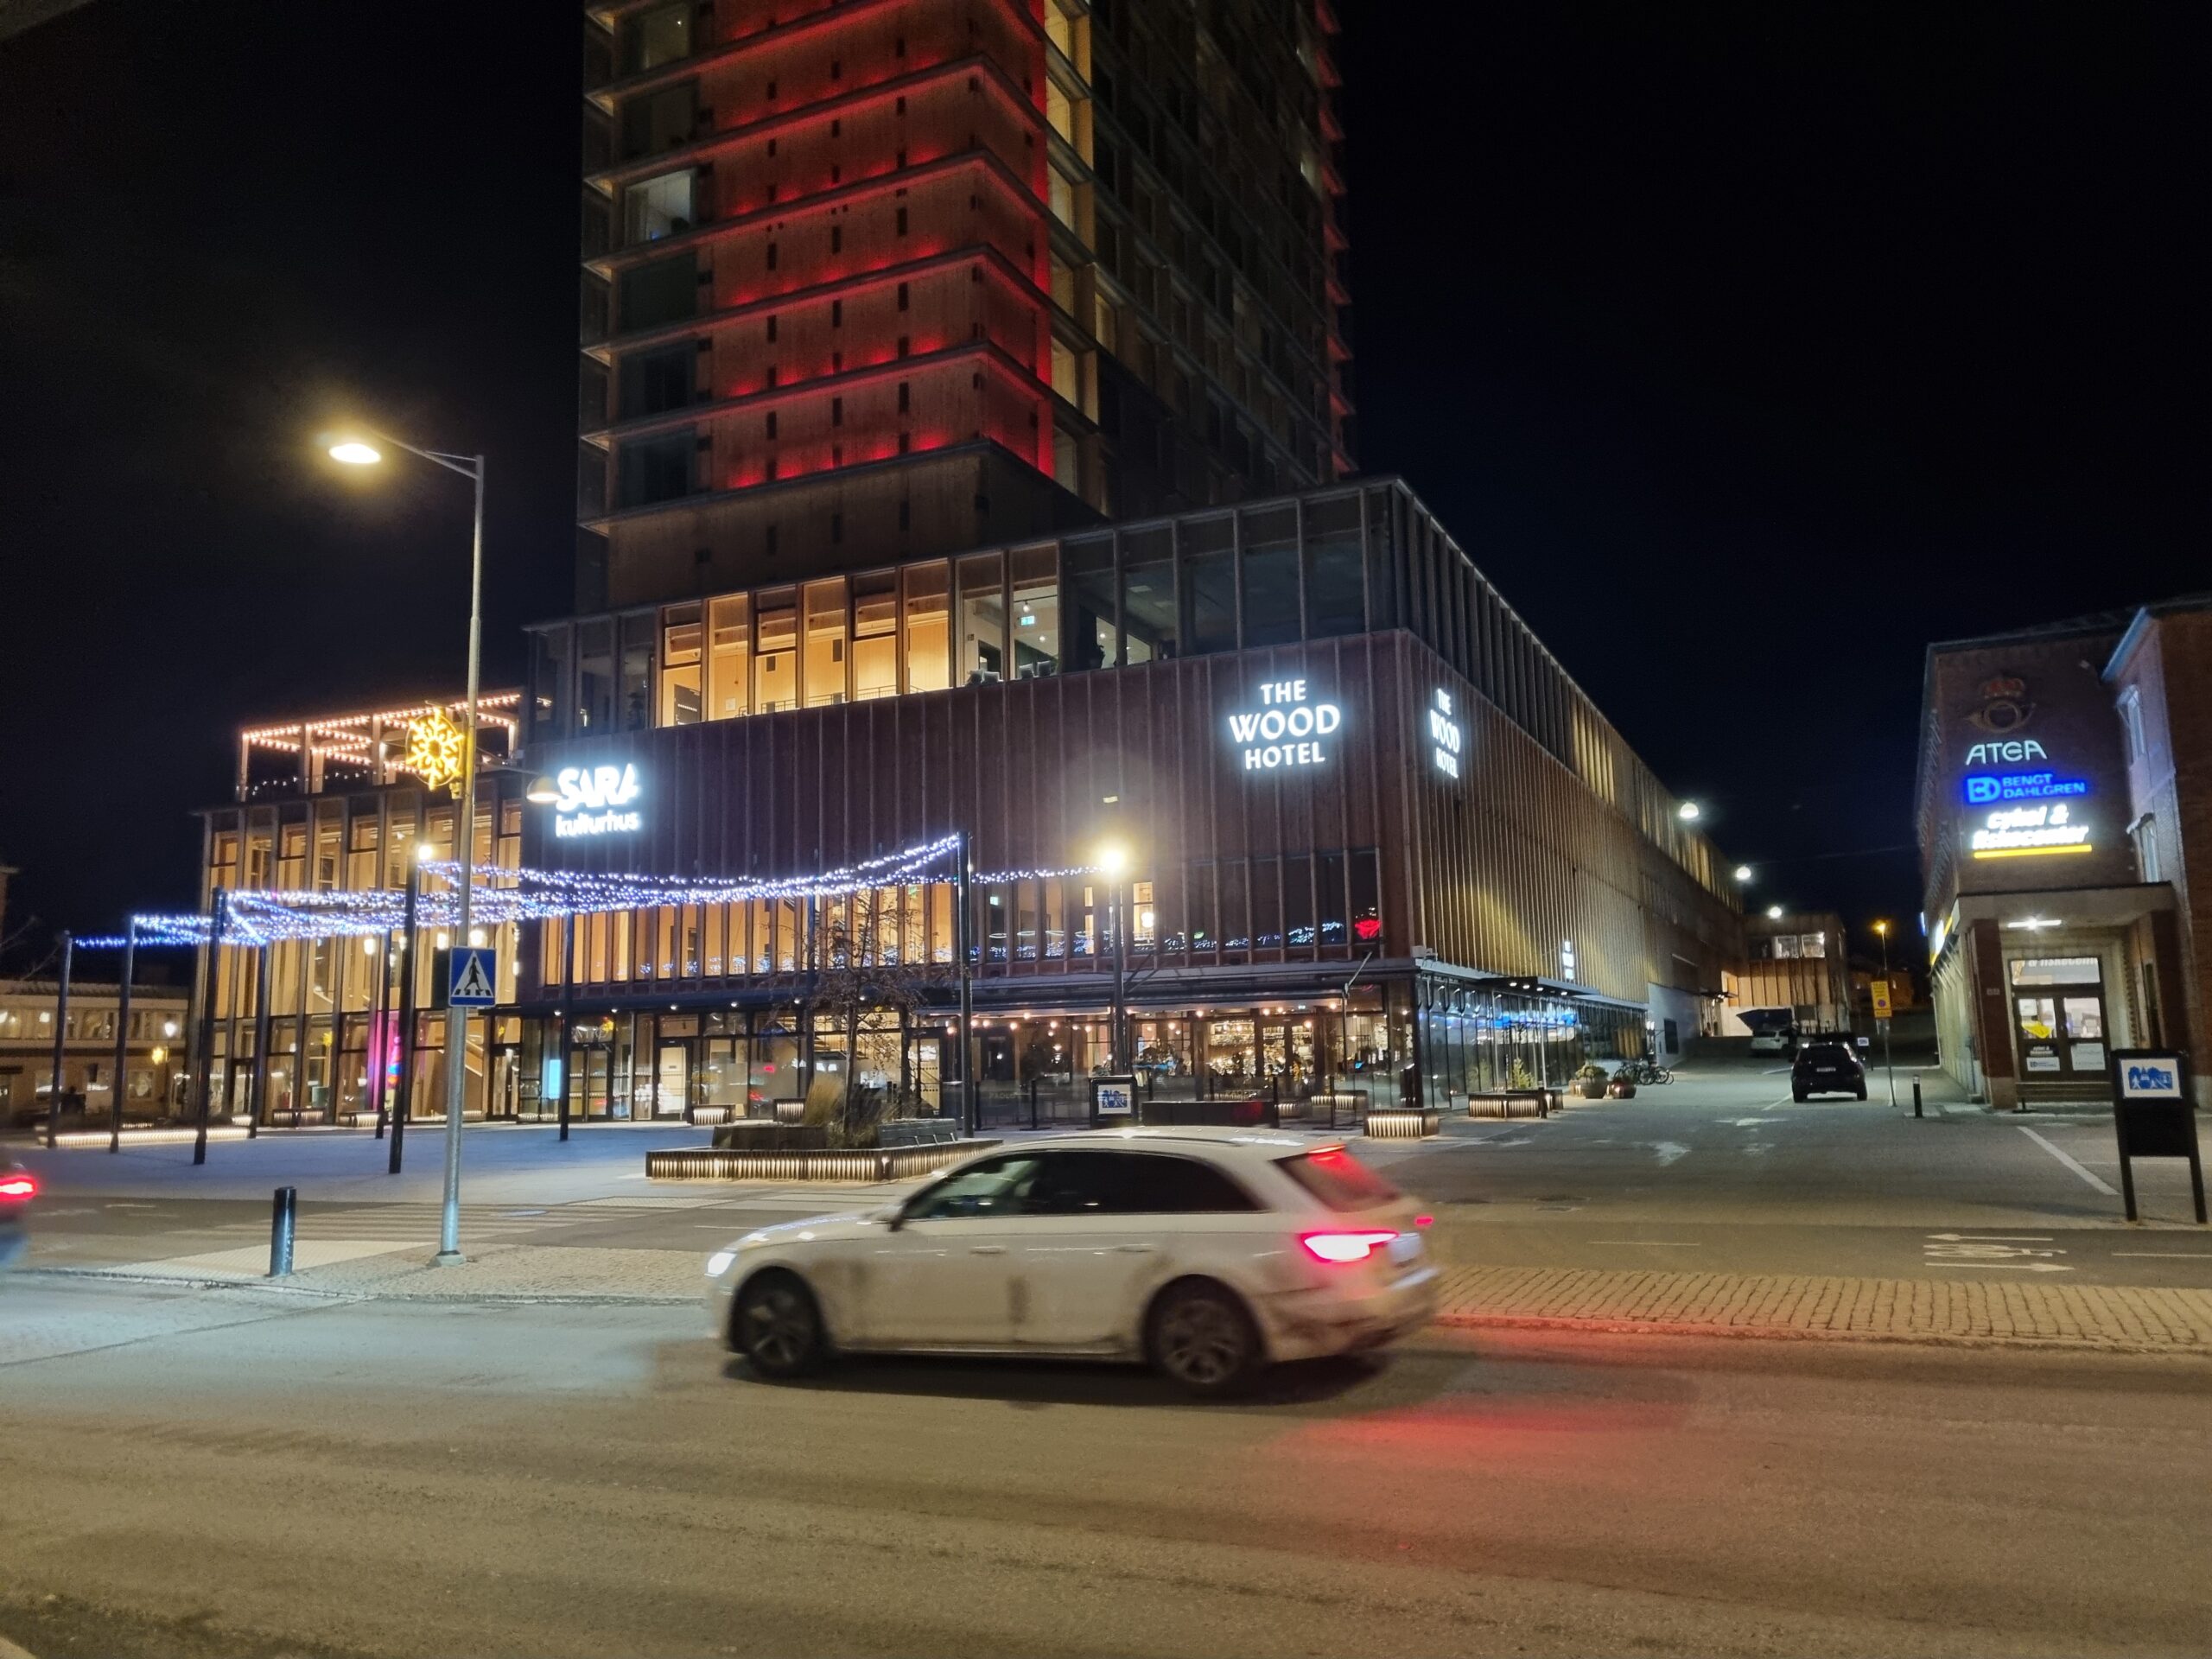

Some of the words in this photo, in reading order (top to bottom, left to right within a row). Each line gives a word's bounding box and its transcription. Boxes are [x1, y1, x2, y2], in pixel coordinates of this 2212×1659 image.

[1259, 679, 1306, 704] THE
[1436, 688, 1452, 715] THE
[1229, 704, 1341, 743] WOOD
[1430, 709, 1461, 753] WOOD
[1244, 741, 1325, 770] HOTEL
[1435, 747, 1459, 779] HOTEL
[1965, 740, 2048, 766] ATEA
[556, 763, 639, 811] SARA
[2002, 773, 2054, 787] BENGT
[2004, 782, 2086, 799] DAHLGREN
